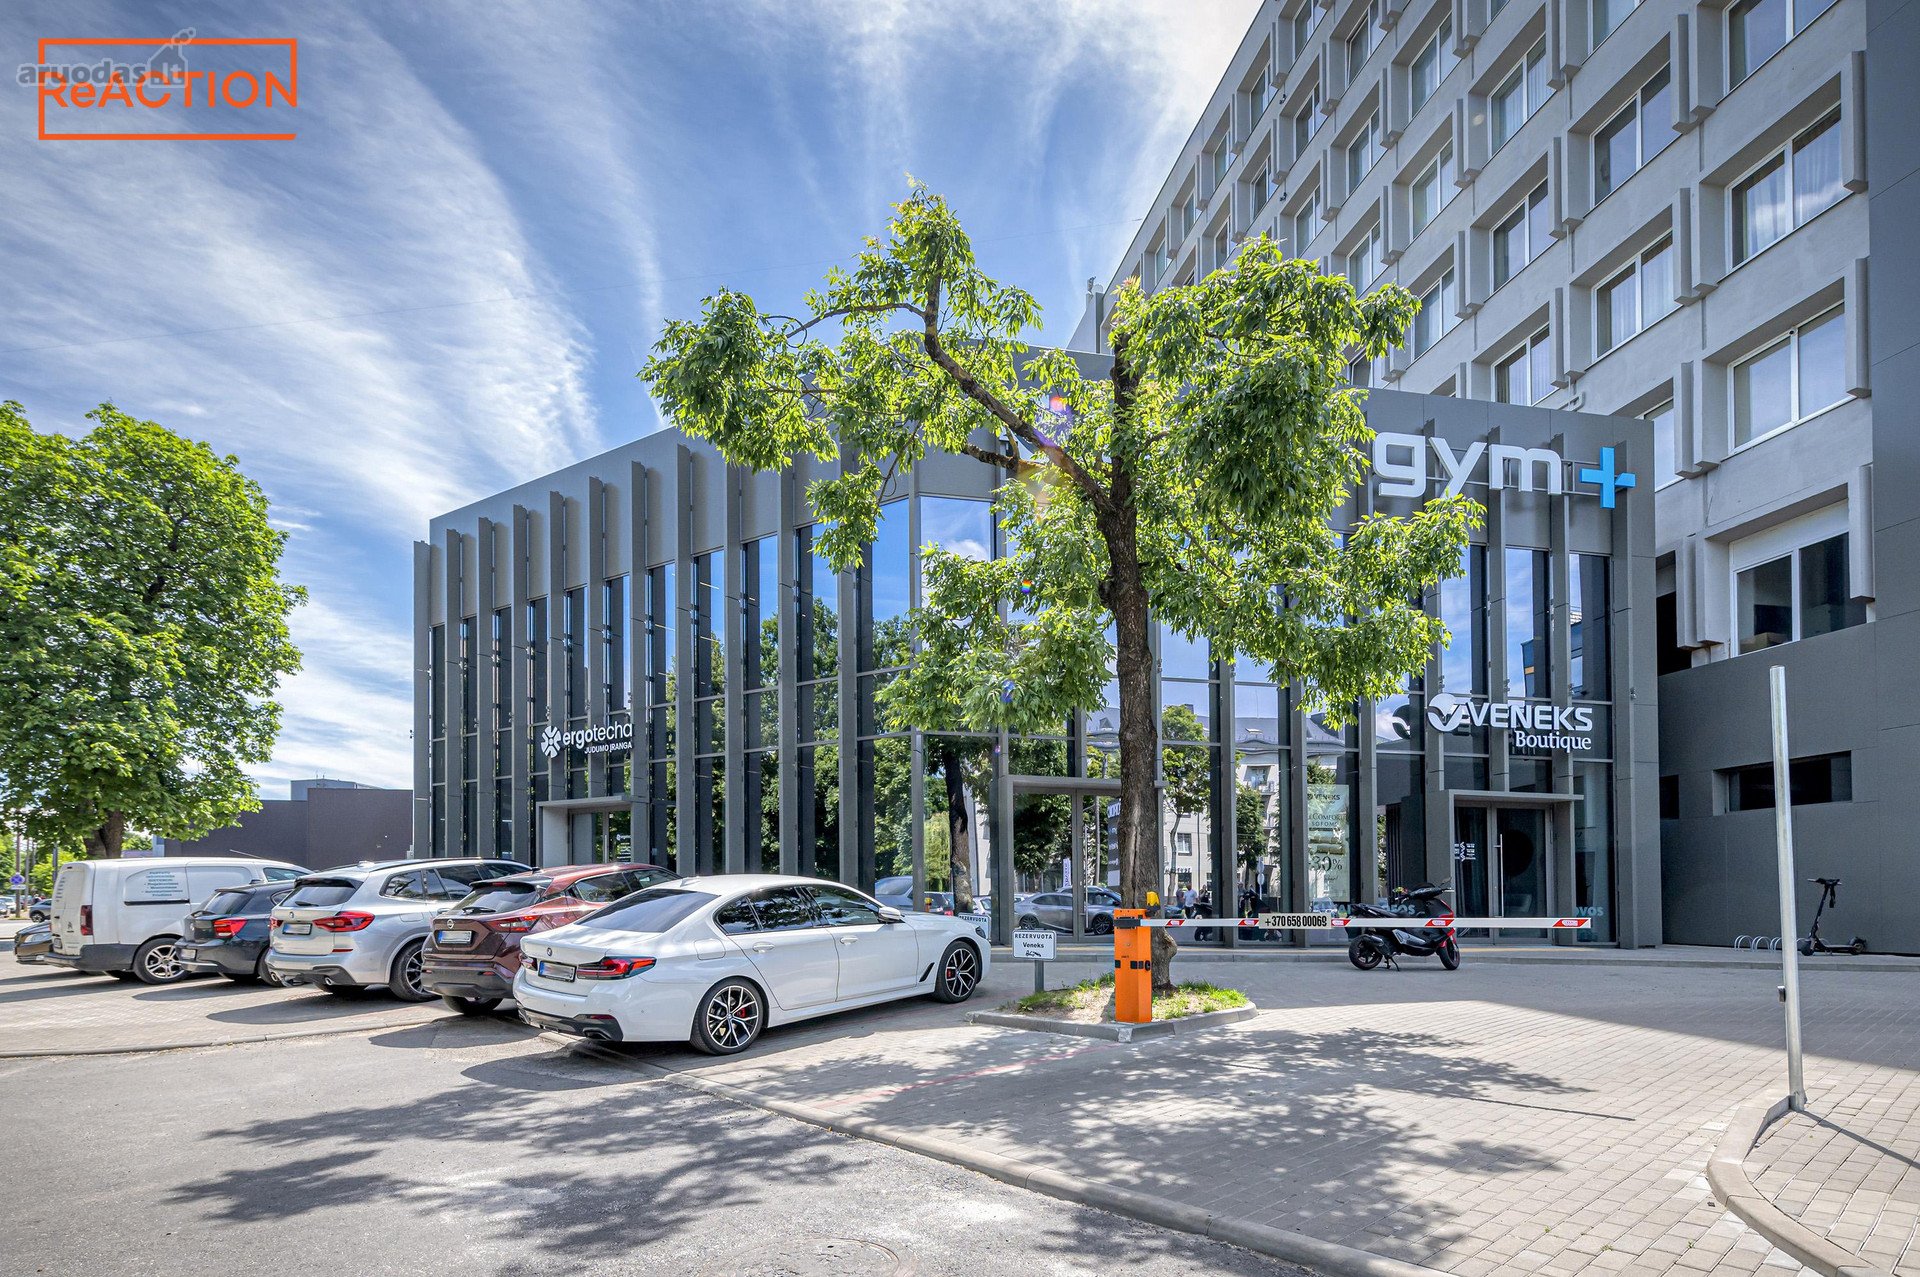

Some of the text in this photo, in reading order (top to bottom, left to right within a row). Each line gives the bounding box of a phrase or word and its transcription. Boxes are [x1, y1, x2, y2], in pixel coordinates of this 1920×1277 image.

[1466, 701, 1593, 732] VENEKS
[562, 721, 633, 749] ergotecha
[1515, 731, 1592, 753] Boutique
[584, 744, 609, 754] JUDUMO
[1265, 916, 1286, 927] +370
[1287, 915, 1301, 927] 658
[1303, 916, 1327, 927] 00069
